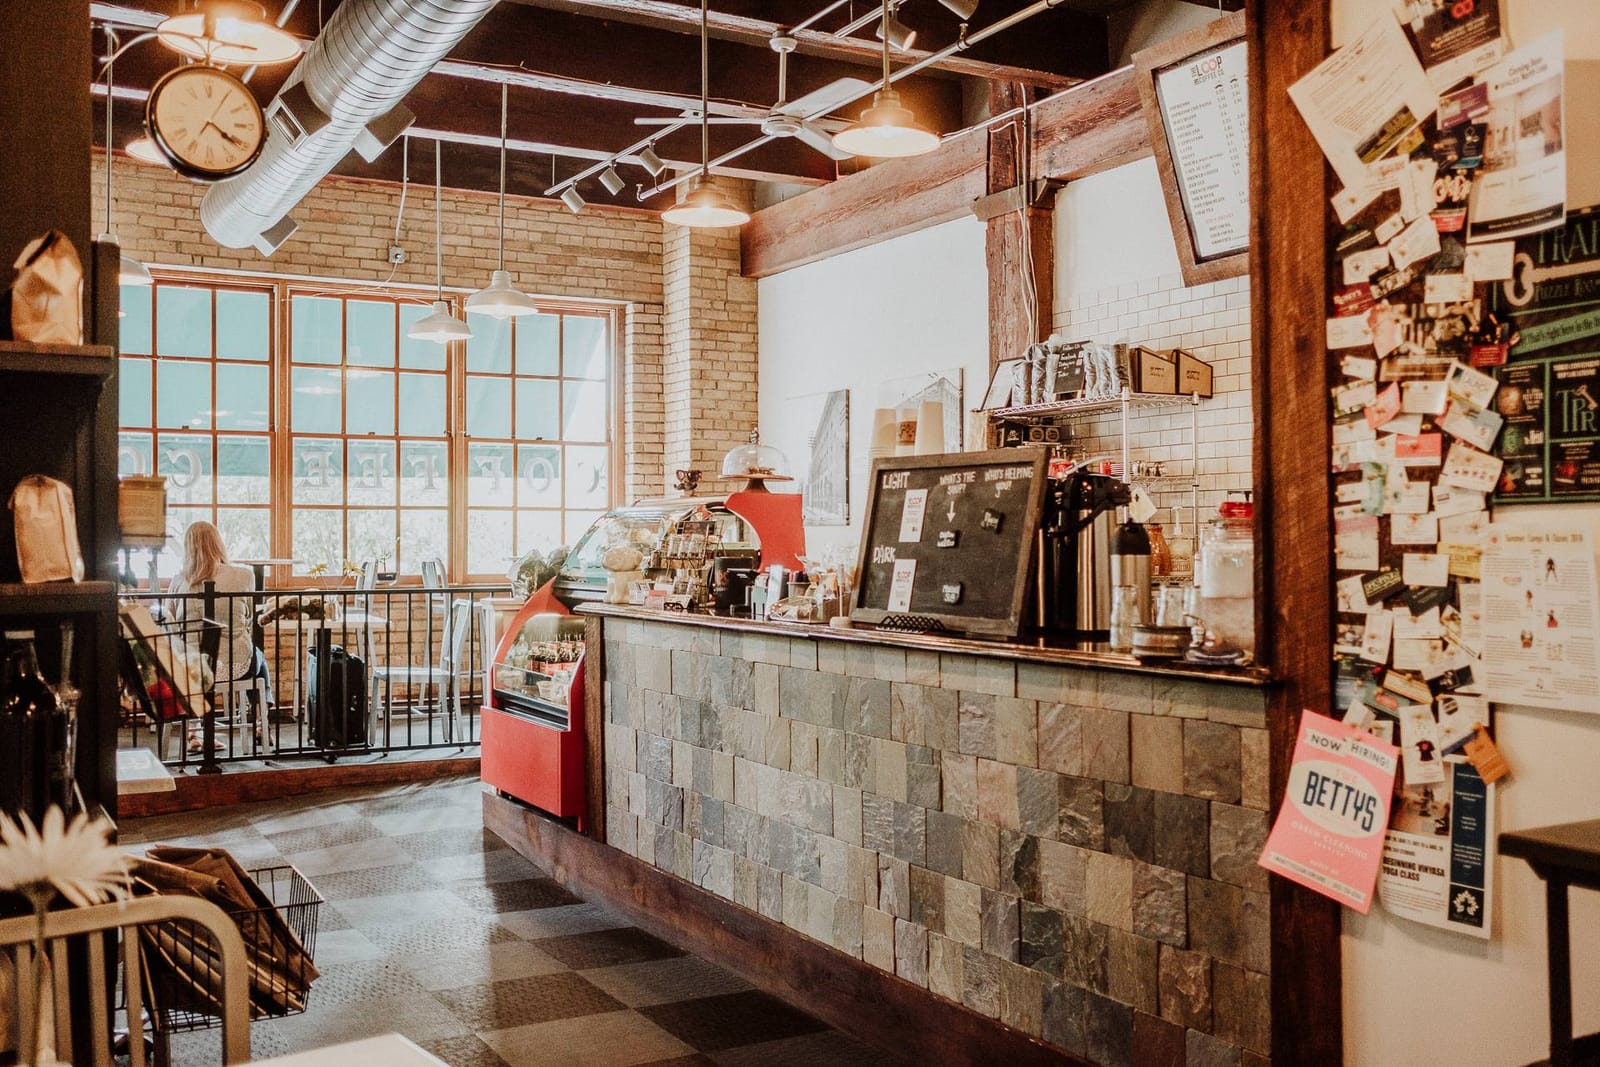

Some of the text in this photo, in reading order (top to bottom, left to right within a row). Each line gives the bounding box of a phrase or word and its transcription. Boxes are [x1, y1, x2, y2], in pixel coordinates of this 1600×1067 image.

[1195, 55, 1222, 77] LOOP
[882, 471, 910, 490] LIGHT
[963, 471, 976, 483] THE
[1005, 466, 1034, 480] HELPING
[873, 545, 897, 565] DARK
[1311, 733, 1390, 769] NOW HIRING!
[1303, 770, 1377, 833] BETTYS
[1383, 866, 1420, 882] YOGA CLASS
[1418, 864, 1445, 877] VINYASA
